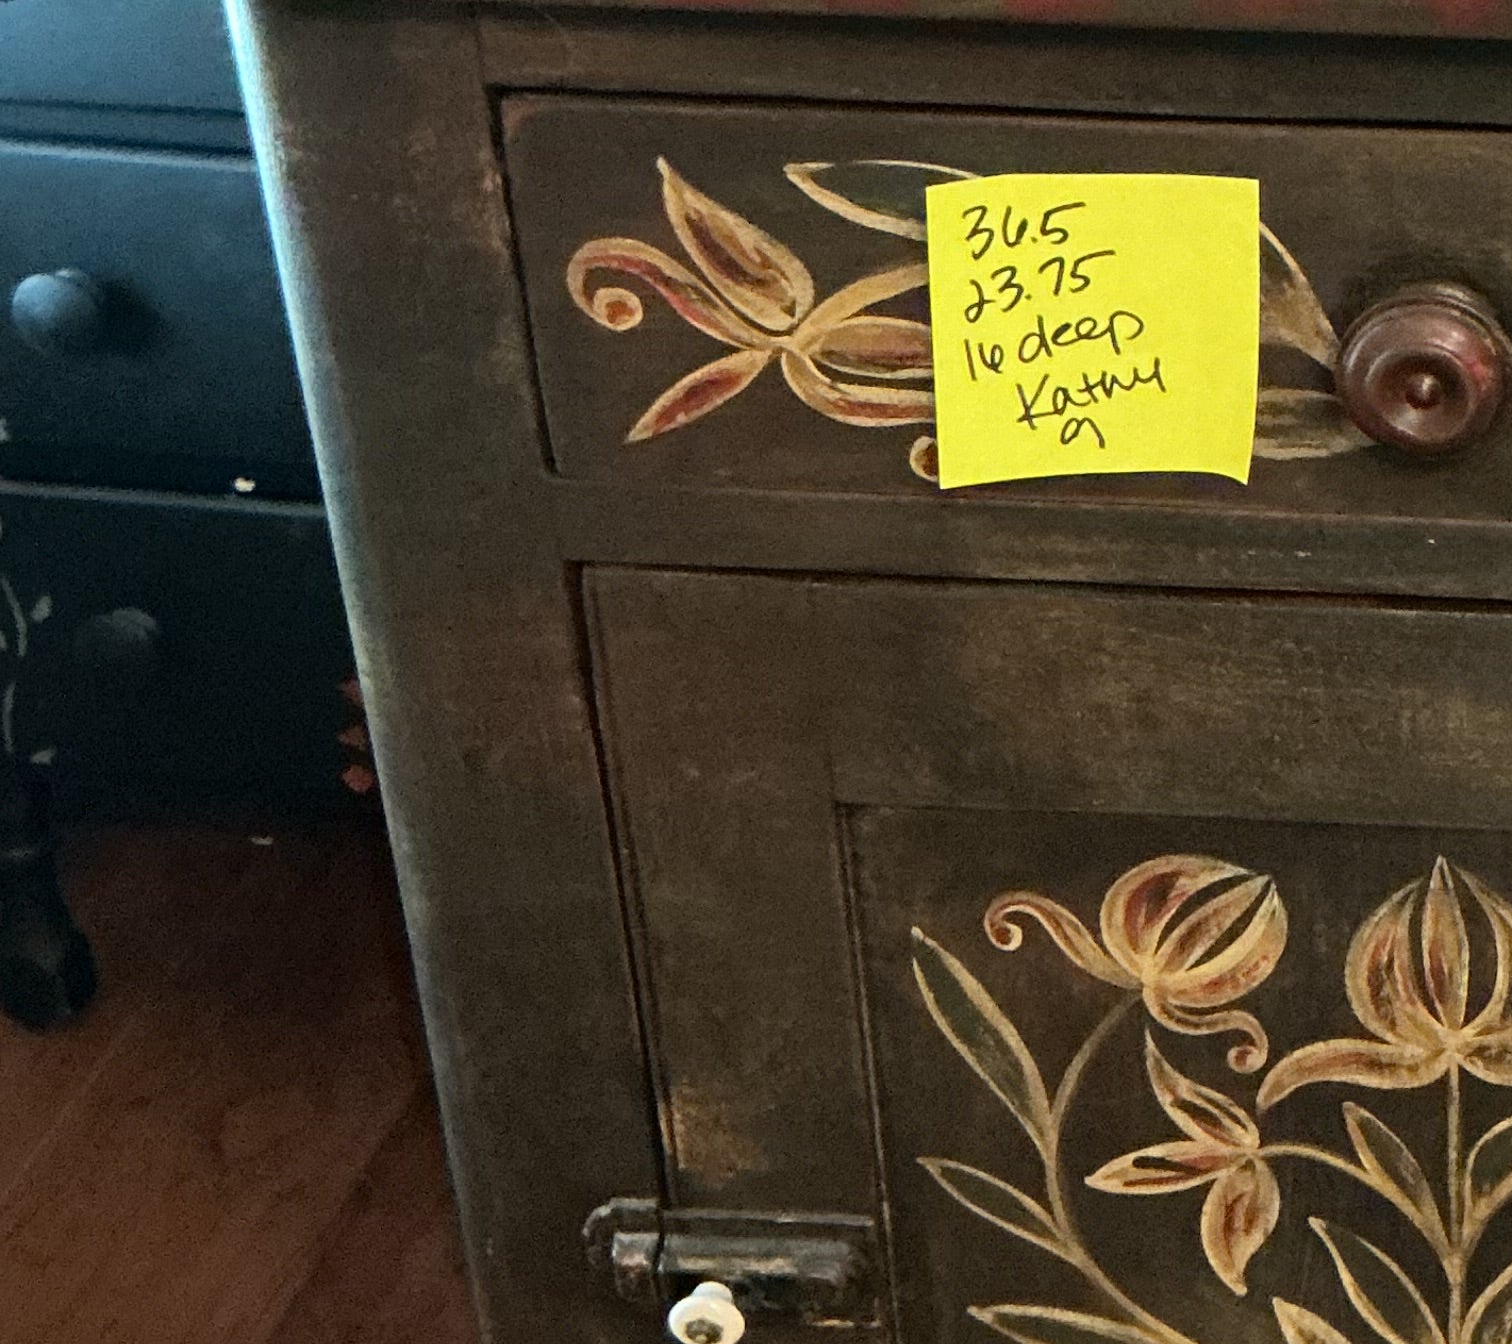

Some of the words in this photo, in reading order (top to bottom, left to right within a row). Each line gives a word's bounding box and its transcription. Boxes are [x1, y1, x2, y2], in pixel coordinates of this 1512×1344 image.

[962, 201, 1087, 260] 36.5
[964, 249, 1117, 324] 23.75
[963, 338, 1004, 382] 16
[1017, 310, 1145, 364] deep
[1015, 357, 1167, 431] Kathy
